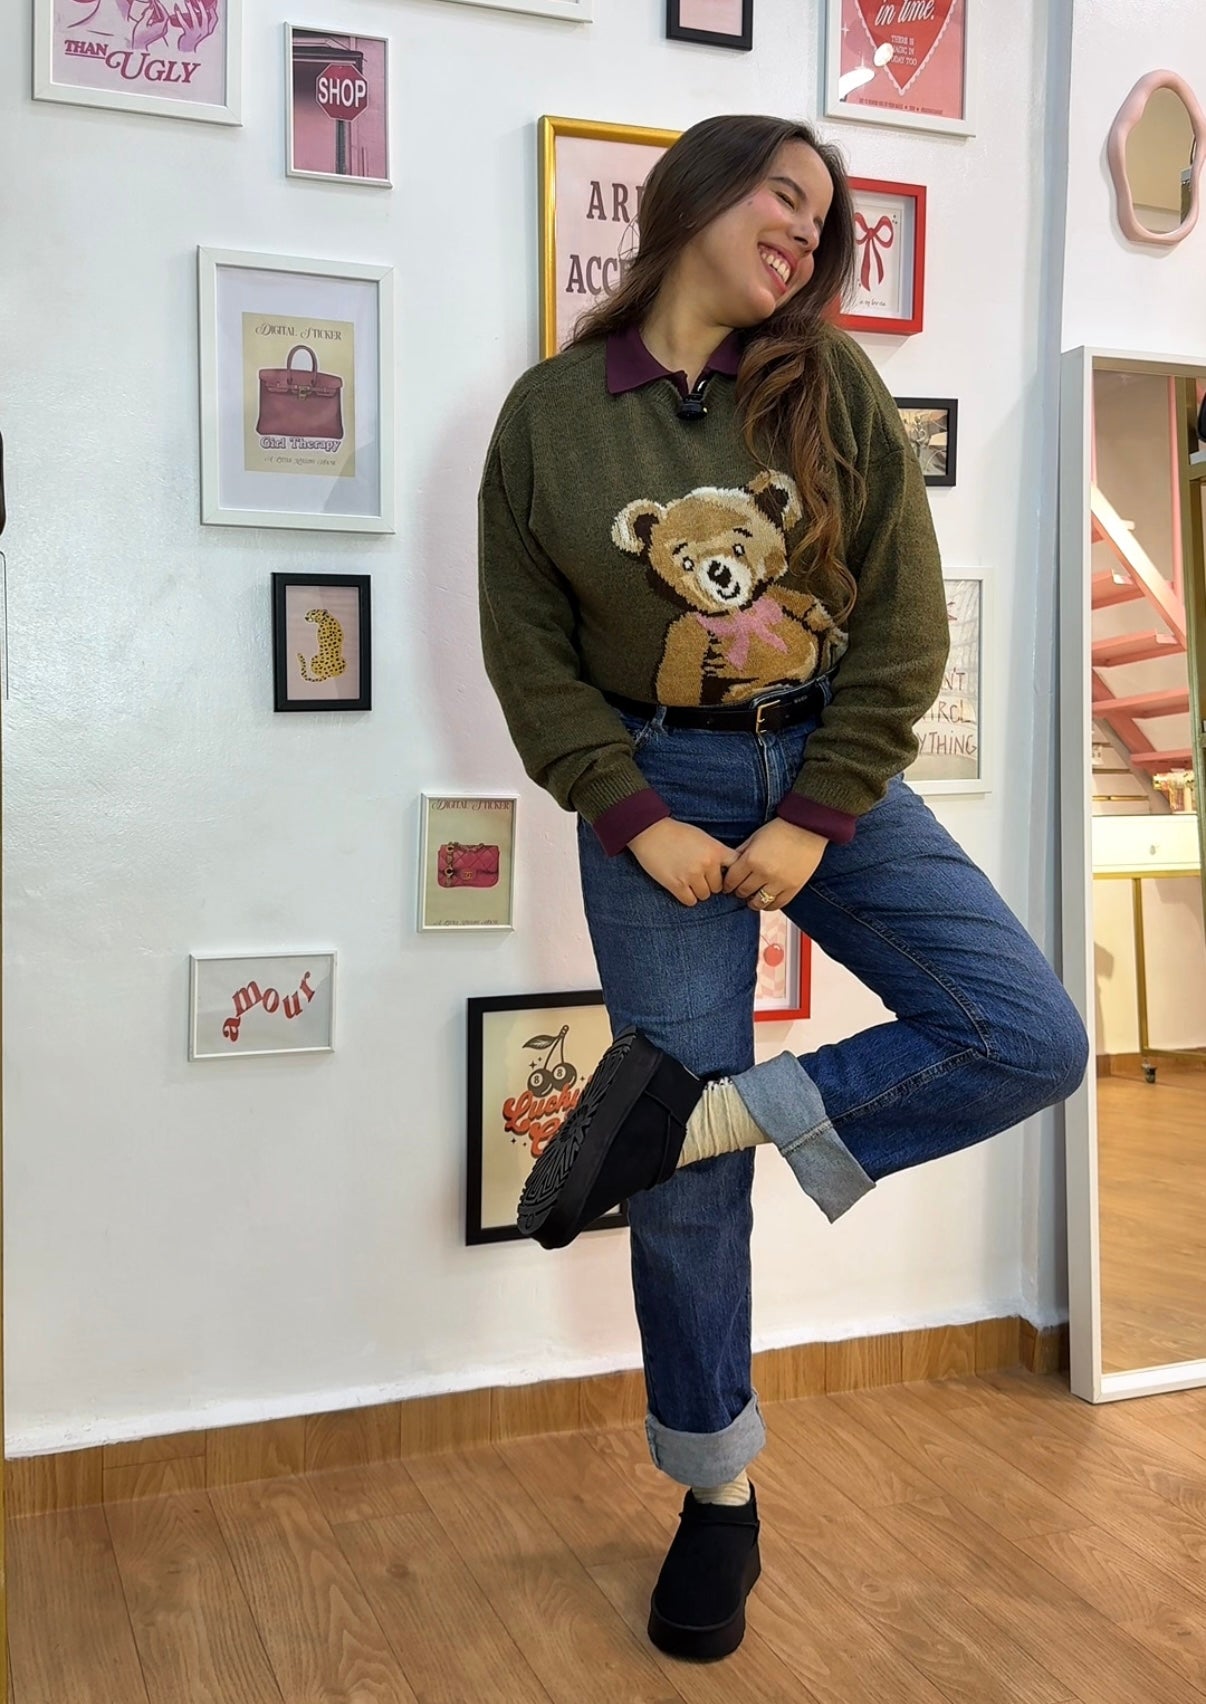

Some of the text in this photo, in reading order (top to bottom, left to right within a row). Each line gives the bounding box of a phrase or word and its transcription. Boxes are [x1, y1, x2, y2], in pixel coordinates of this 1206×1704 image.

[64, 40, 108, 57] THAN
[105, 51, 201, 83] UGLY
[318, 77, 366, 108] SHOP
[260, 436, 341, 453] Girl Therapy
[917, 731, 977, 756] YTHING
[222, 971, 315, 1042] amour
